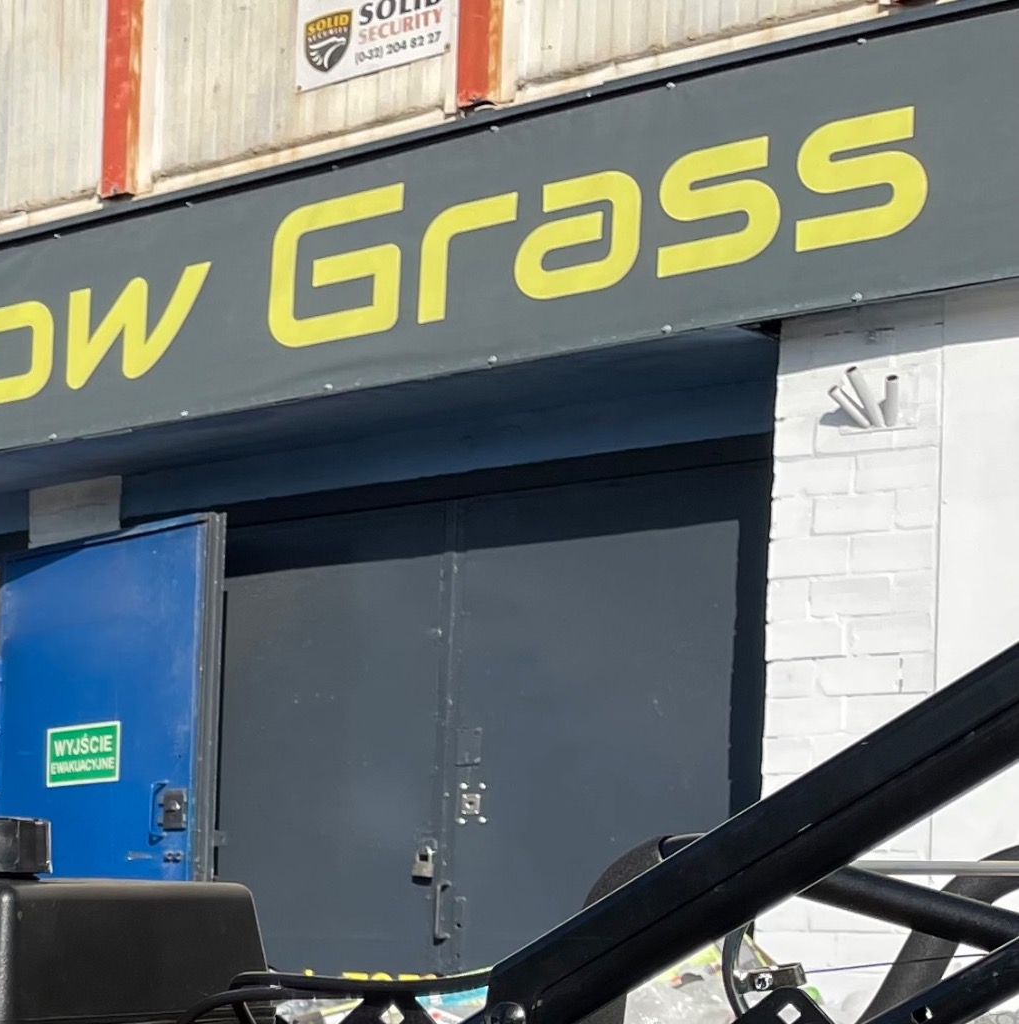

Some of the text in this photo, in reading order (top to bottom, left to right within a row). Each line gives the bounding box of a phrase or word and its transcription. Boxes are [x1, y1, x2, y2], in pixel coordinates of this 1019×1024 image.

[307, 13, 350, 36] SOLID
[359, 7, 442, 45] SECURITY
[386, 40, 407, 55] 204
[410, 35, 424, 48] 82
[427, 30, 442, 44] 27
[268, 106, 929, 348] Grass
[54, 732, 113, 757] WYJŚCIE
[50, 757, 115, 775] EWAKUACYJNE
